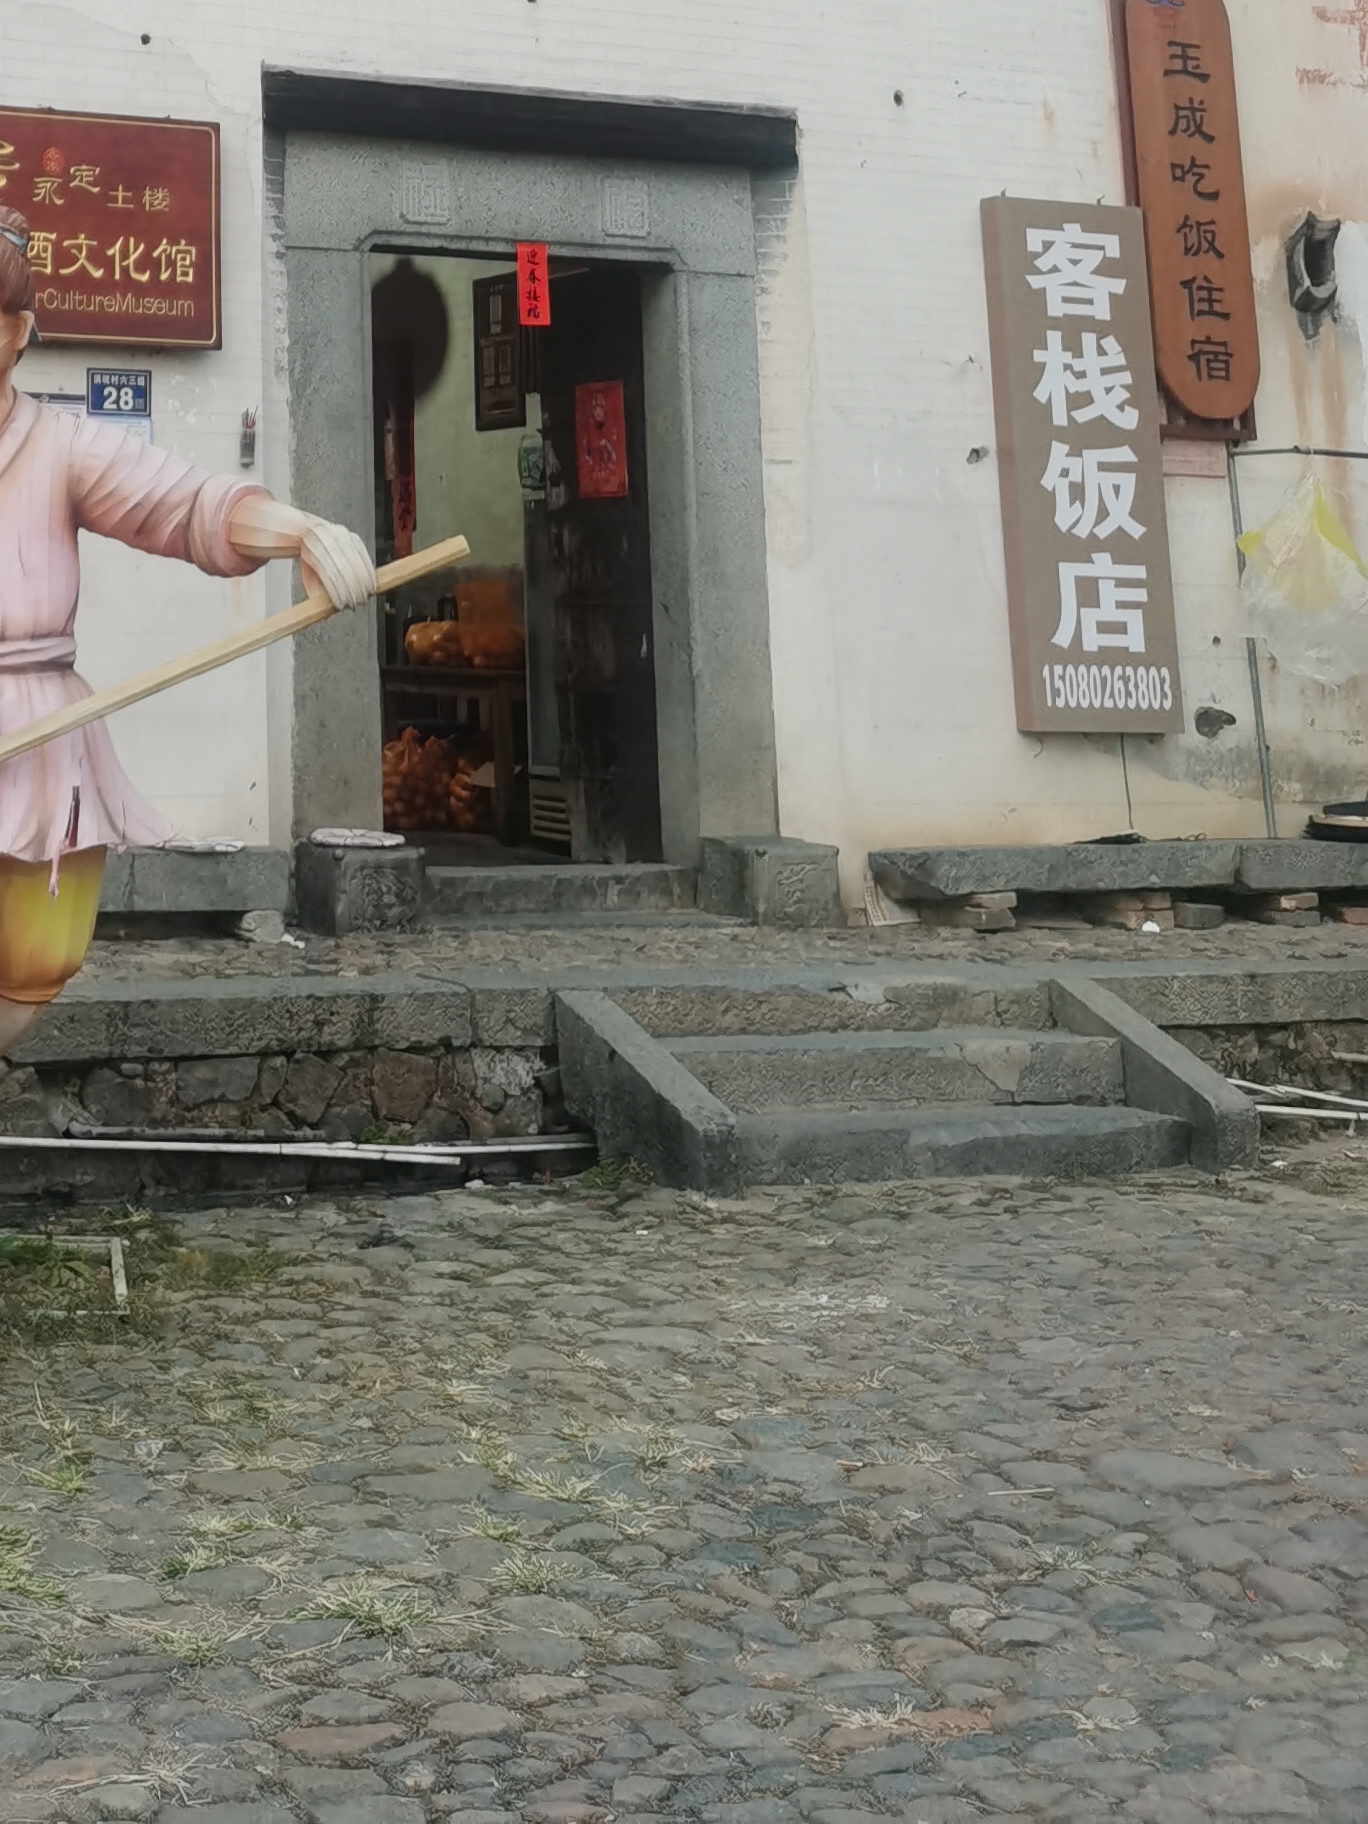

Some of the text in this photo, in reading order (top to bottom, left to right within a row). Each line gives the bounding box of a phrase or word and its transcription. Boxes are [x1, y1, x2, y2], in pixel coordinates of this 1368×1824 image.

[33, 164, 170, 212] 永定土楼
[1163, 40, 1234, 382] 玉成吃饭住宿
[103, 386, 134, 411] 28
[1025, 223, 1147, 653] 客栈饭店
[1043, 664, 1173, 711] 15080263803
